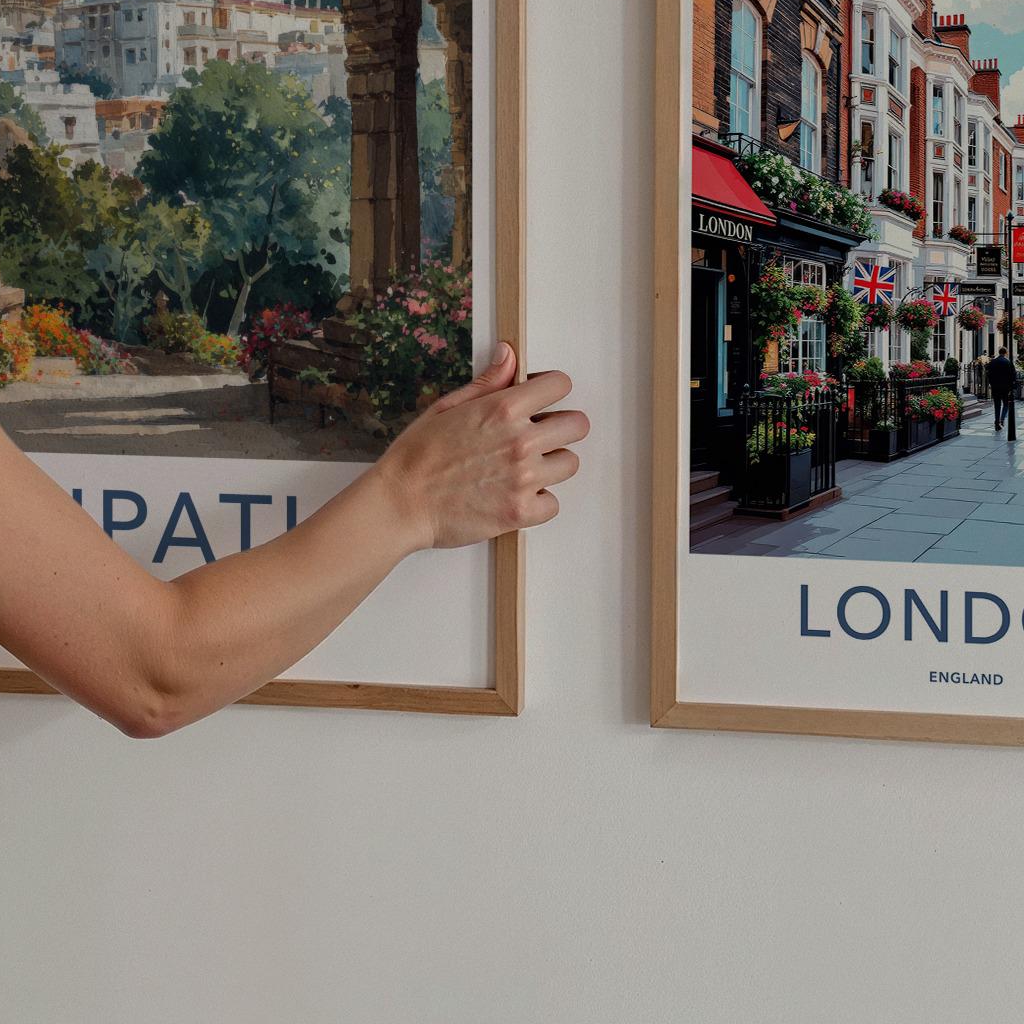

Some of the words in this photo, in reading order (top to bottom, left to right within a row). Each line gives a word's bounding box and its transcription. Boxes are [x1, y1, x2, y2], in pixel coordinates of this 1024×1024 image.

[698, 213, 753, 242] LONDON
[800, 583, 1024, 644] LOND
[929, 671, 1004, 686] ENGLAND
